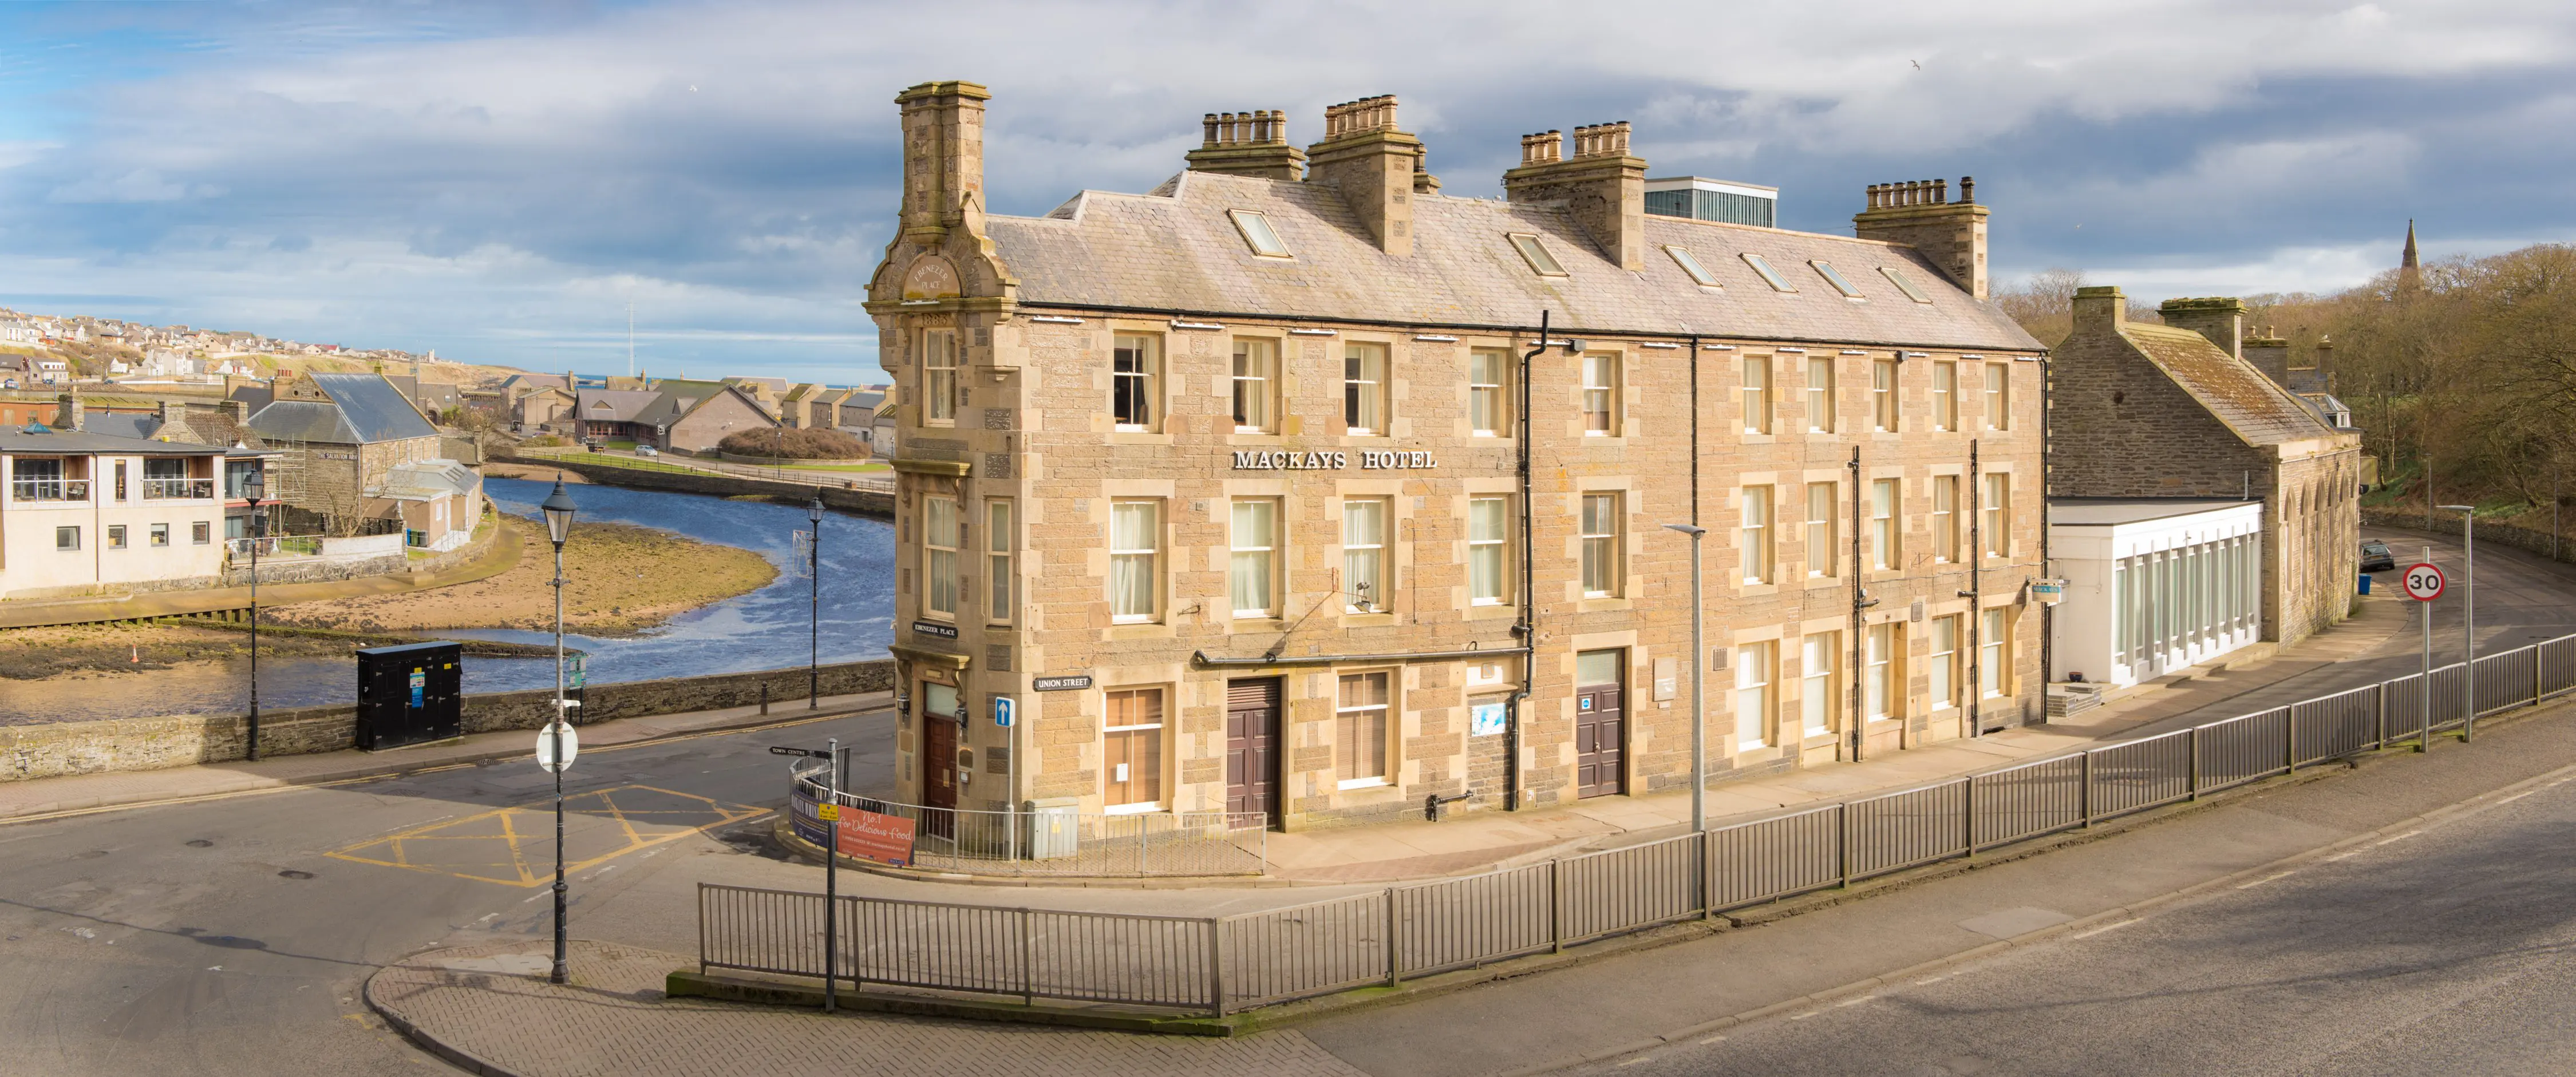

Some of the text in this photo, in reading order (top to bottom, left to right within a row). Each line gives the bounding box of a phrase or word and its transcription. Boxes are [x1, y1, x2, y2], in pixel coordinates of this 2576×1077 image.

[914, 265, 948, 282] EBENEZER
[922, 281, 940, 289] PLACE
[1235, 450, 1437, 469] MACKAYS HOTEL
[2409, 575, 2439, 590] 30
[915, 624, 938, 633] EBENEZER
[1038, 678, 1088, 688] UNION STREET
[863, 811, 881, 824] No.1
[852, 819, 887, 836] Delicious
